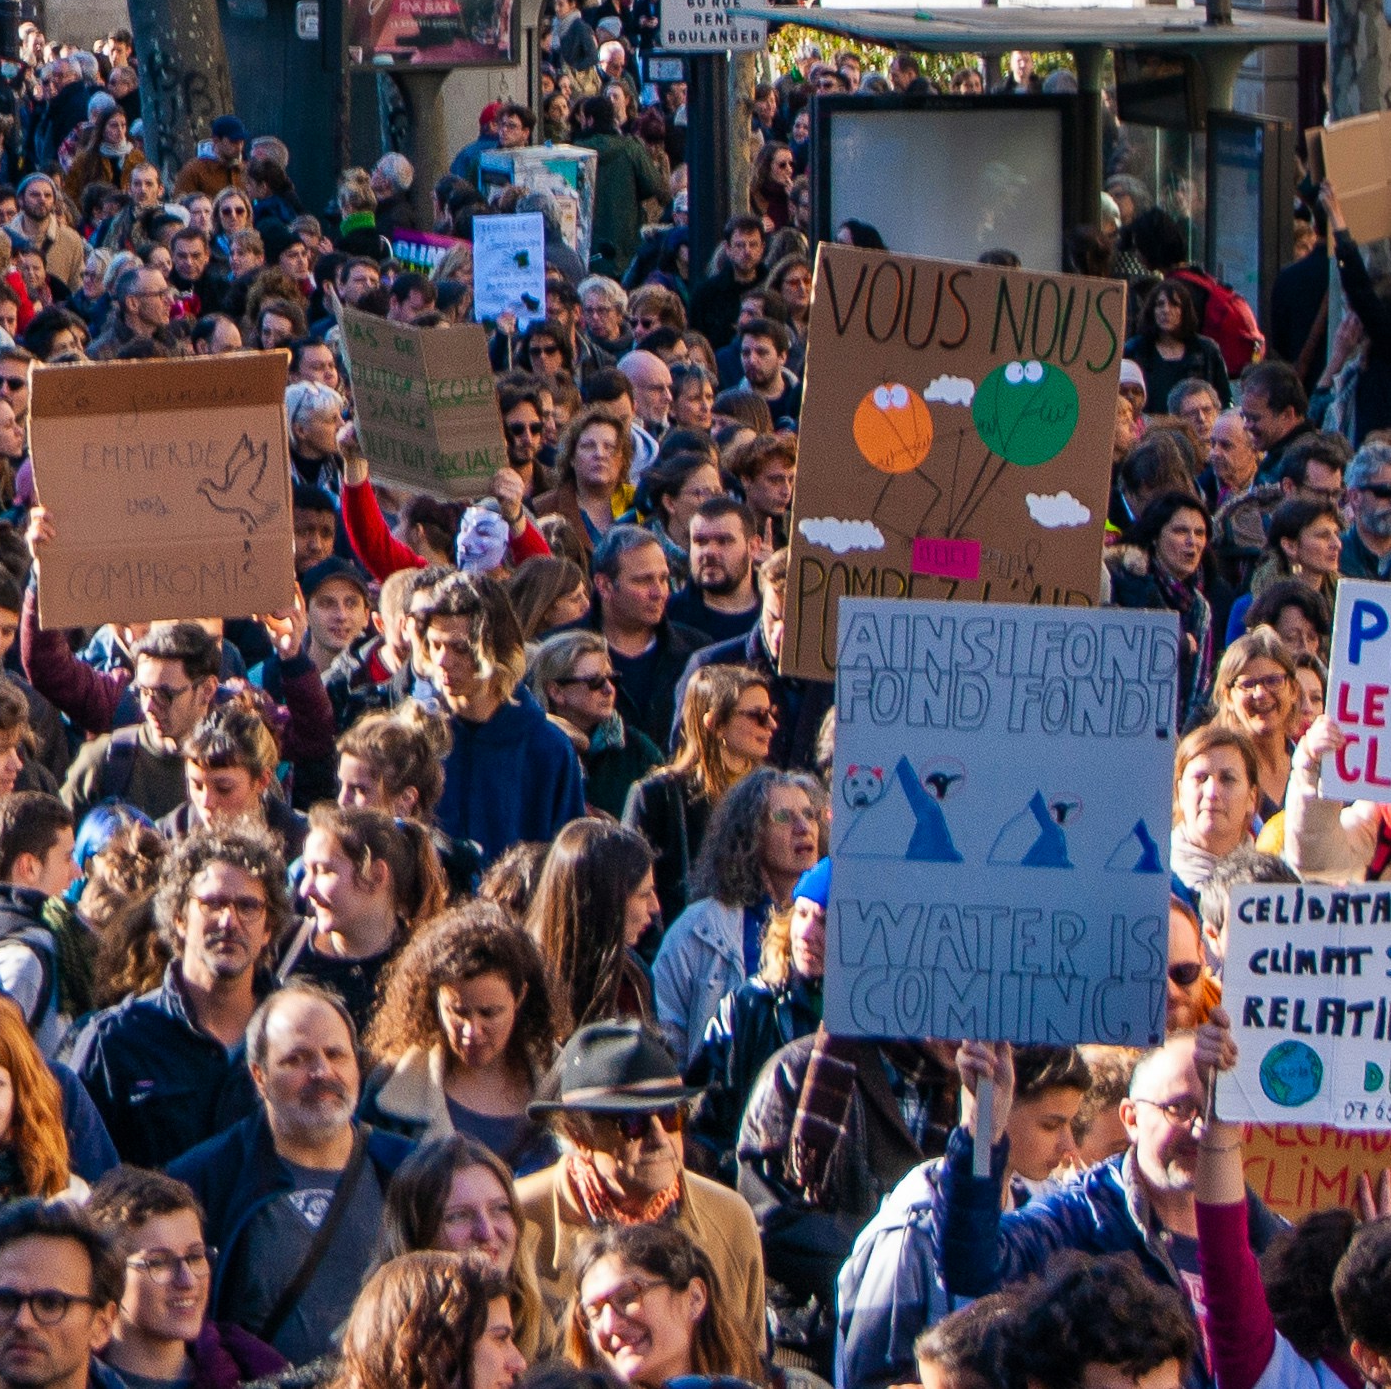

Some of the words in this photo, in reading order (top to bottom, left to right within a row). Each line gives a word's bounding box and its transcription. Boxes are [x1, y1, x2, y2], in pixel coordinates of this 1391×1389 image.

[667, 29, 761, 45] BOULANGER
[821, 256, 973, 351] VOUS
[989, 274, 1122, 374] NOUS
[81, 440, 222, 473] EMMERDE
[68, 560, 263, 603] COMPROMIS
[836, 611, 1017, 677] AINSI
[1030, 619, 1179, 685] FOND
[835, 666, 990, 731] FOND
[1336, 679, 1390, 728] LE
[835, 899, 1088, 978] WATER
[1110, 914, 1165, 979] IS
[1248, 941, 1373, 977] CLIMAT
